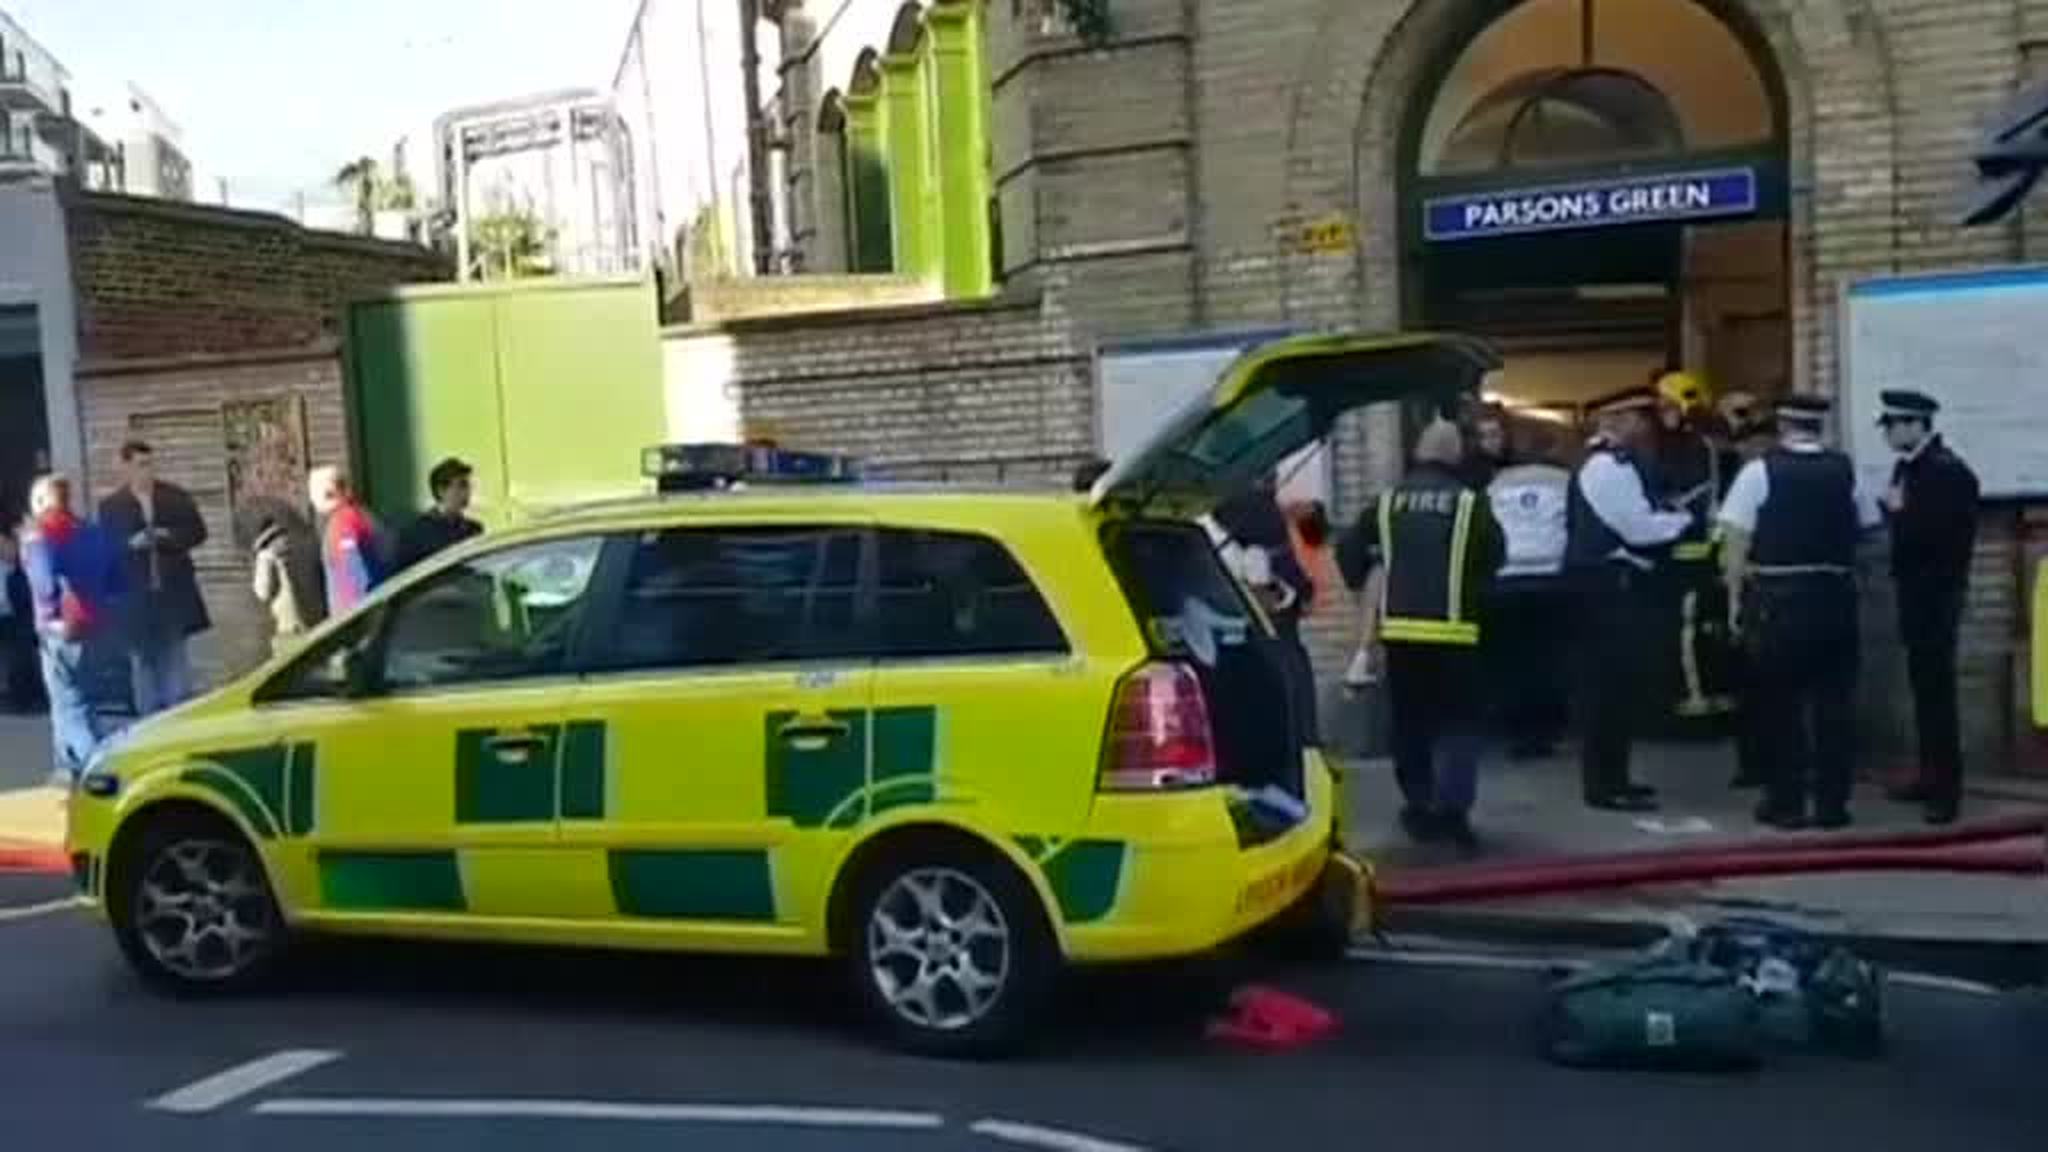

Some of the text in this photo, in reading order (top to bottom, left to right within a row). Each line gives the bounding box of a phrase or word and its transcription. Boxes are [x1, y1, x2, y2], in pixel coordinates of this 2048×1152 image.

[1464, 181, 1711, 229] PARSONS GREEN
[1392, 488, 1454, 514] FIRE
